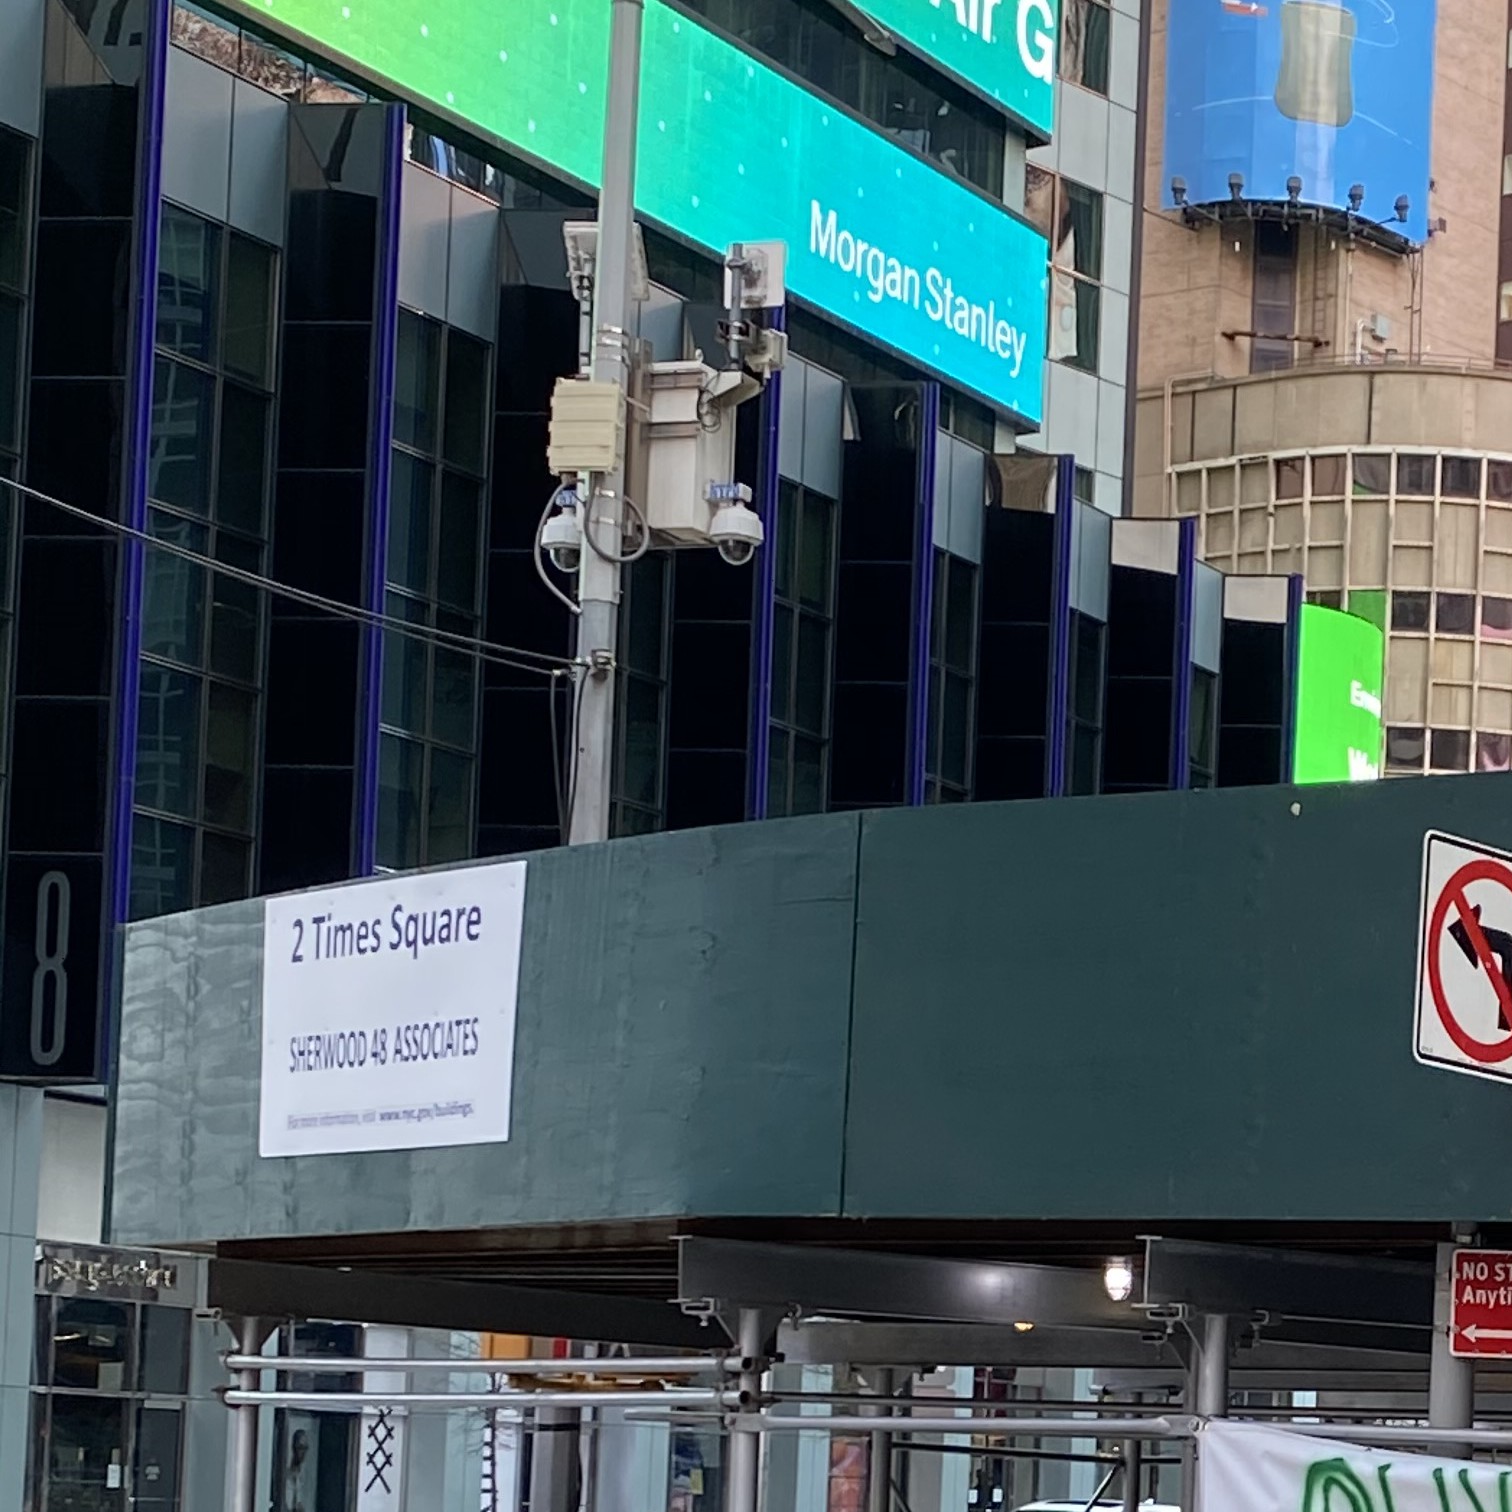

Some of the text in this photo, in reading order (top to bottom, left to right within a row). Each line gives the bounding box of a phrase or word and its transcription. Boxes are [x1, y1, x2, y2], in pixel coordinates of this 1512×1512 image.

[810, 199, 1027, 378] Morgan Stanley
[291, 904, 482, 963] 2 Times Square
[30, 870, 71, 1066] 8
[289, 1017, 479, 1073] SHERWOOD 48 ASSOCIATES
[1462, 1262, 1489, 1281] NO
